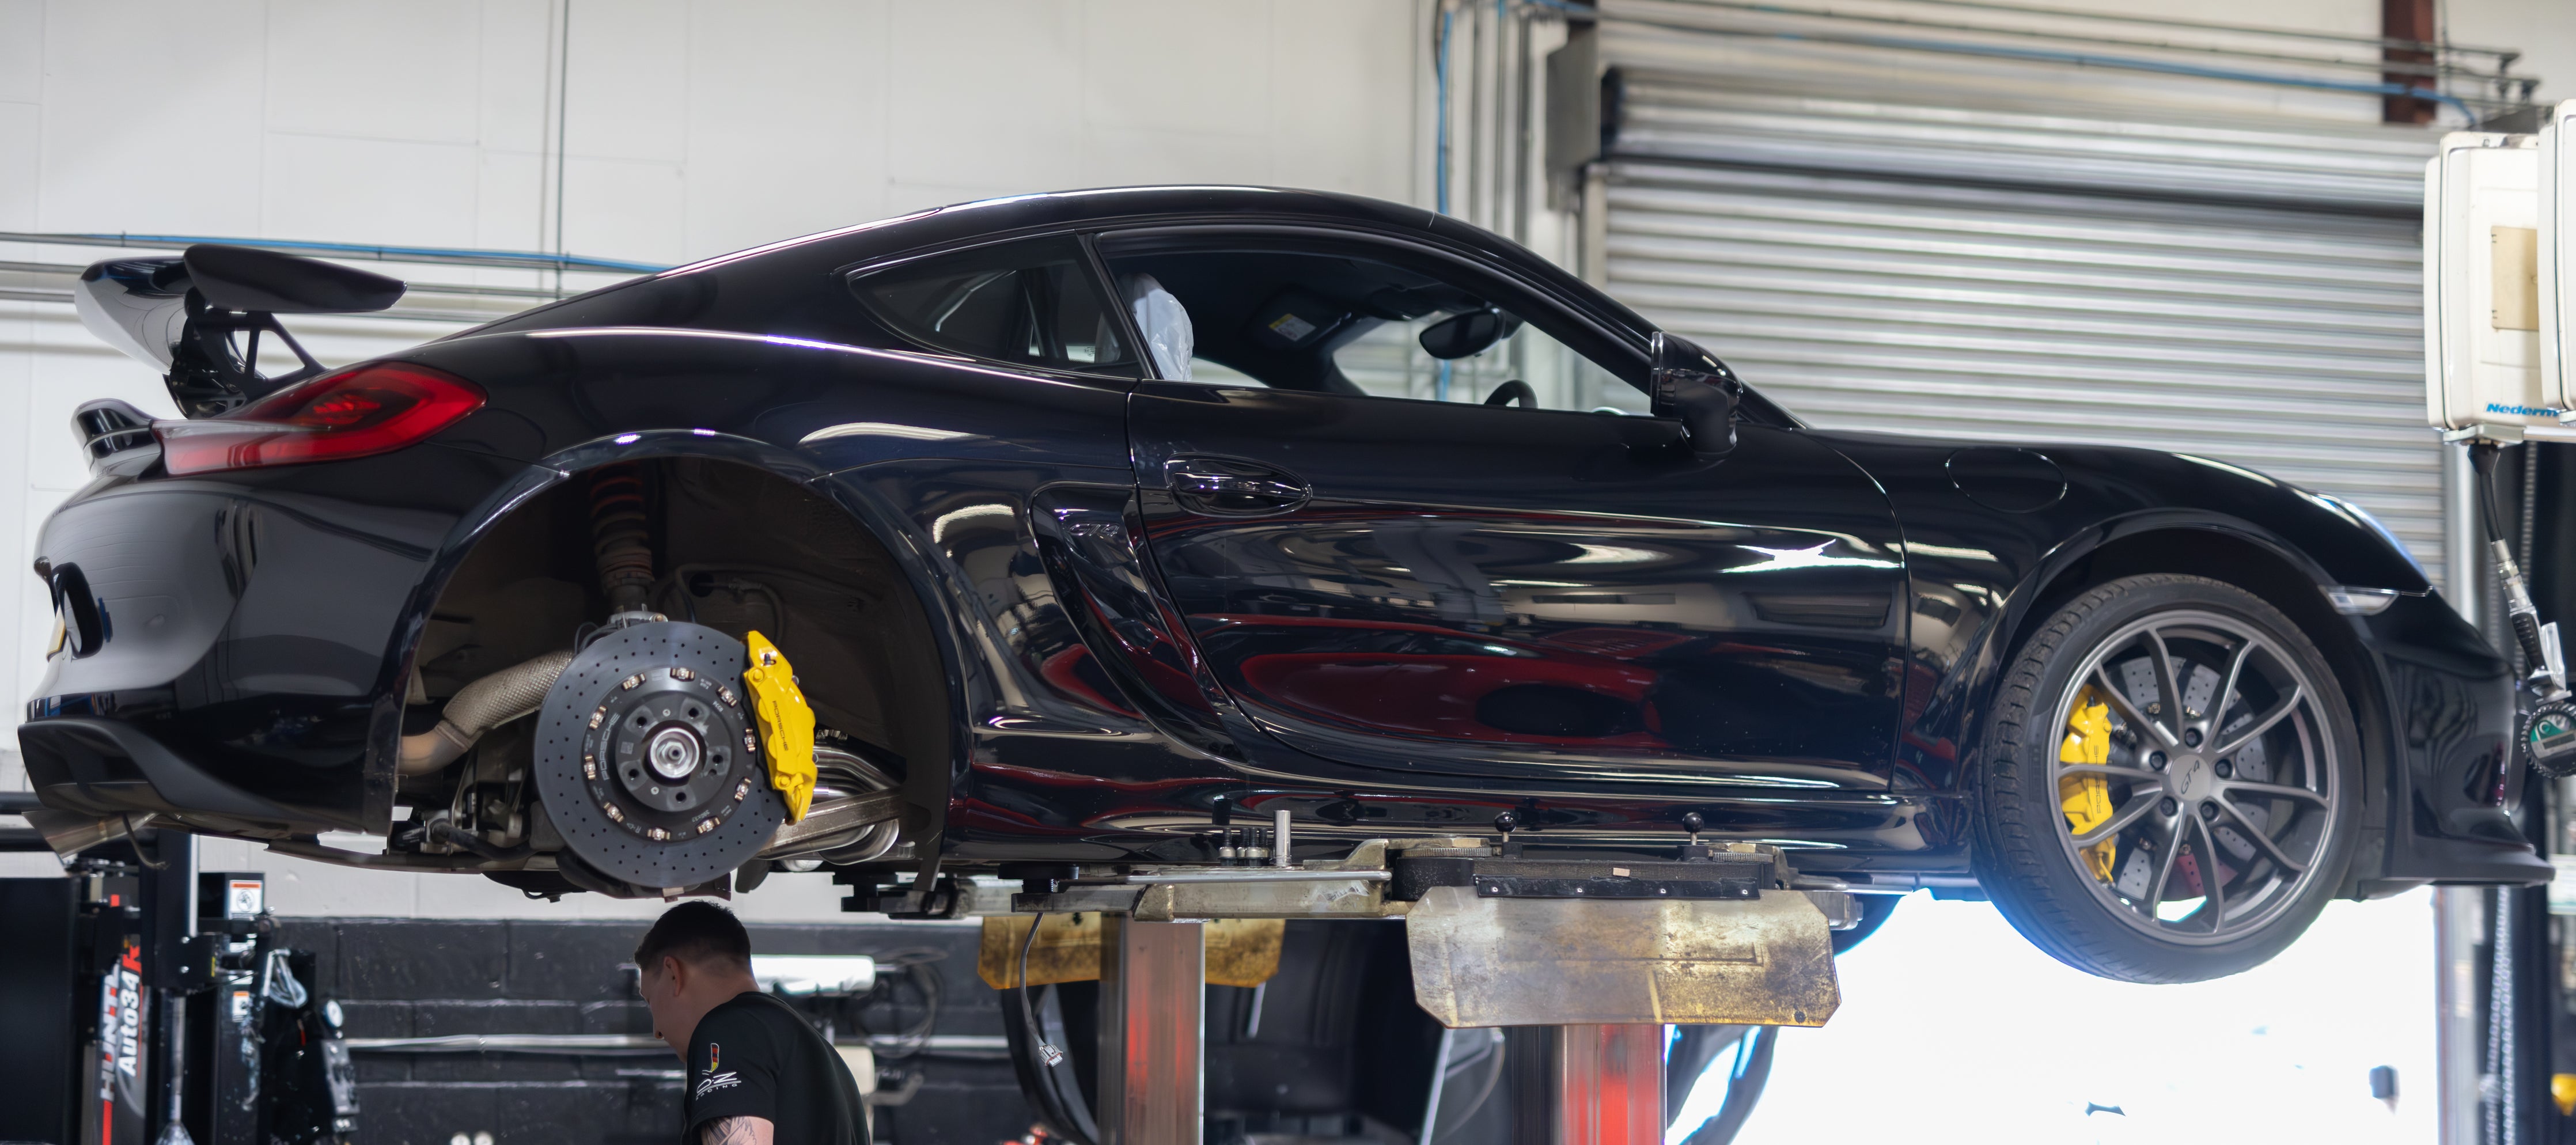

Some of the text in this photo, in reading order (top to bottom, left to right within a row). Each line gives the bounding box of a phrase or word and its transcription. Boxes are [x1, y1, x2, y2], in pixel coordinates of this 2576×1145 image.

[600, 712, 620, 780] PORSCHE
[772, 700, 789, 751] PORSCHE
[2093, 745, 2102, 814] PORSHE
